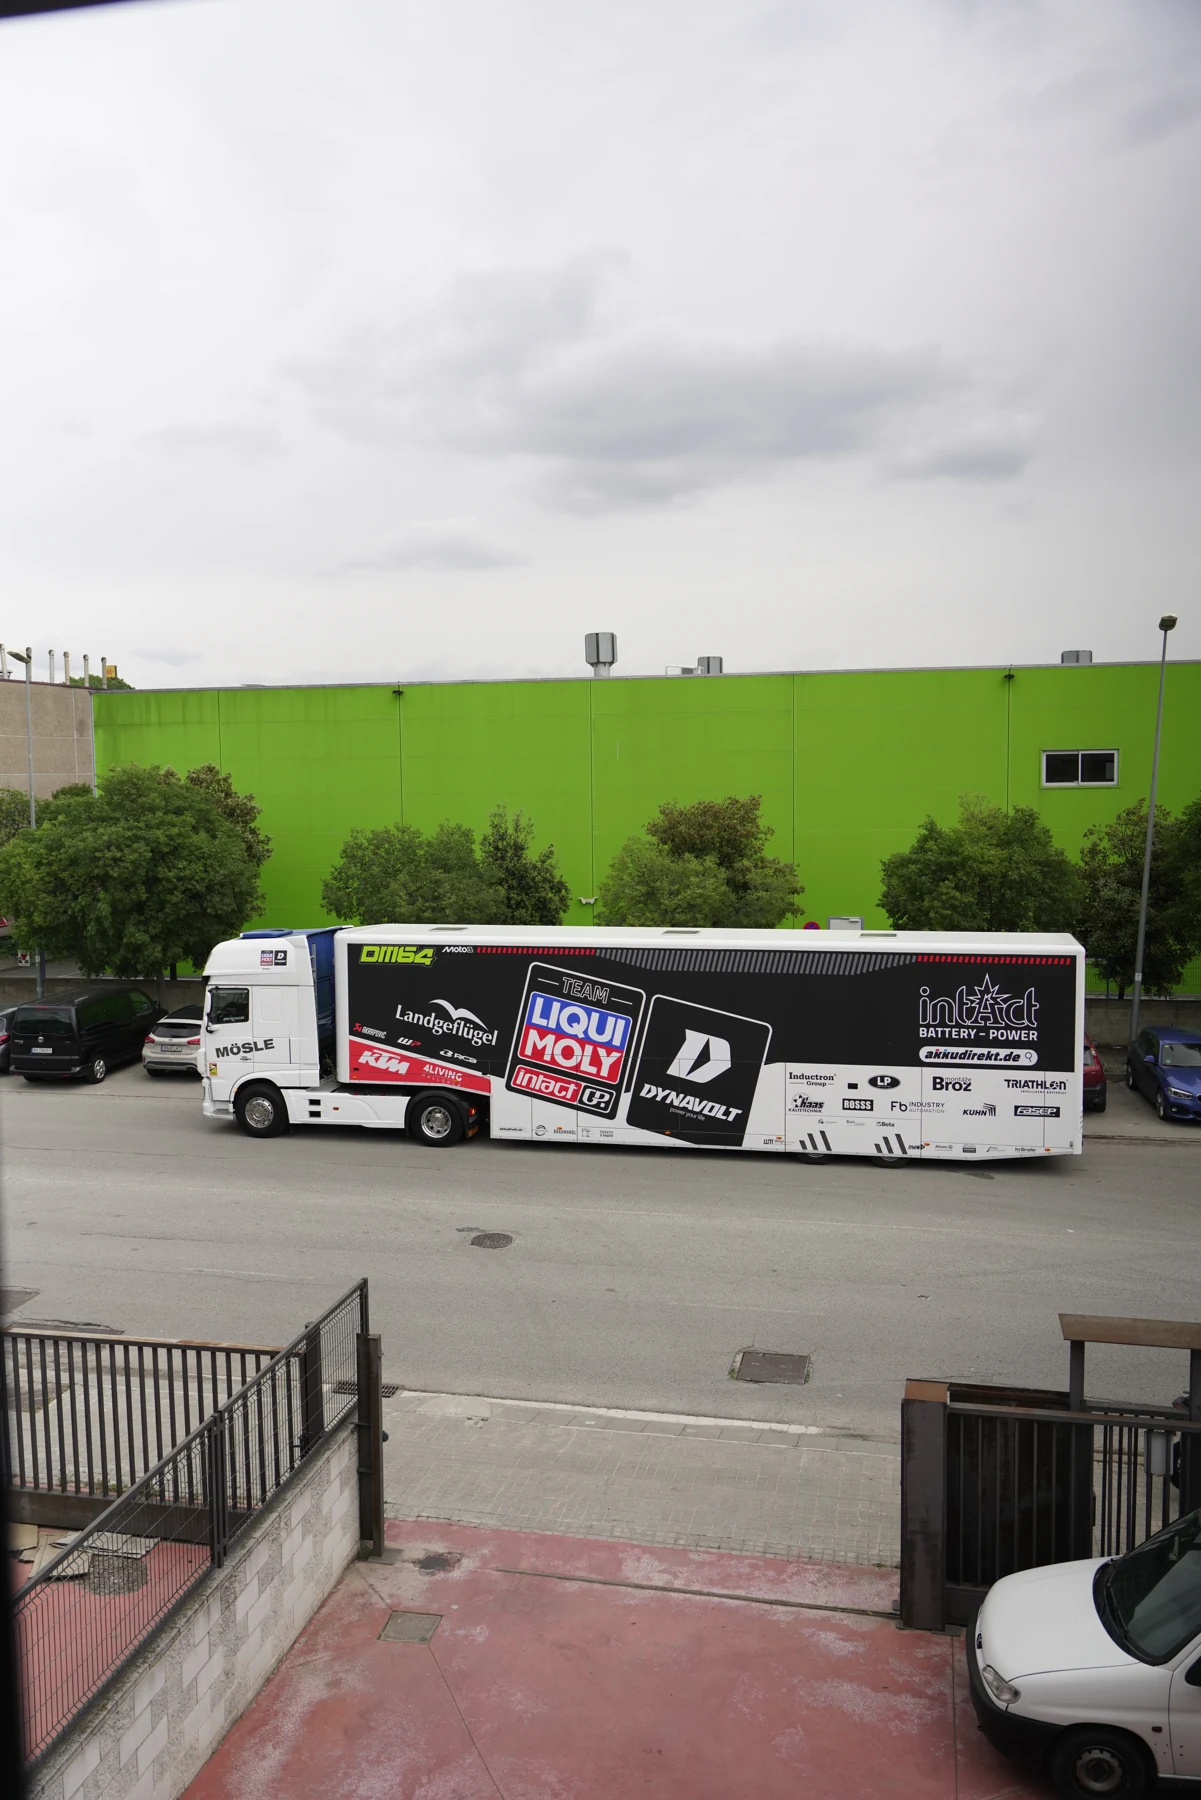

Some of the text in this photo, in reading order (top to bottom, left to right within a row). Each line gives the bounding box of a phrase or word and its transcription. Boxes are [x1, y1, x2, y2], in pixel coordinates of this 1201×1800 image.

[562, 977, 609, 1004] TEAM
[395, 1004, 498, 1047] Landgeflügel
[531, 997, 626, 1047] LIQUI
[919, 1027, 977, 1039] BATTERY
[989, 1029, 1038, 1041] POWER
[215, 1038, 275, 1058] MÖSLE
[524, 1029, 622, 1078] MOLY
[924, 1048, 1021, 1062] akkudirekt.de
[358, 1049, 410, 1075] KTM
[423, 1064, 462, 1081] 4LIVING
[788, 1072, 834, 1081] Inductron
[516, 1069, 578, 1099] intact
[806, 1080, 827, 1088] Group
[877, 1076, 892, 1086] LP
[639, 1083, 743, 1122] DYNAVOLT
[843, 1099, 872, 1110] ROSSS
[890, 1101, 908, 1112] Fb
[669, 1106, 706, 1121] power your life
[962, 1108, 988, 1116] KUHN
